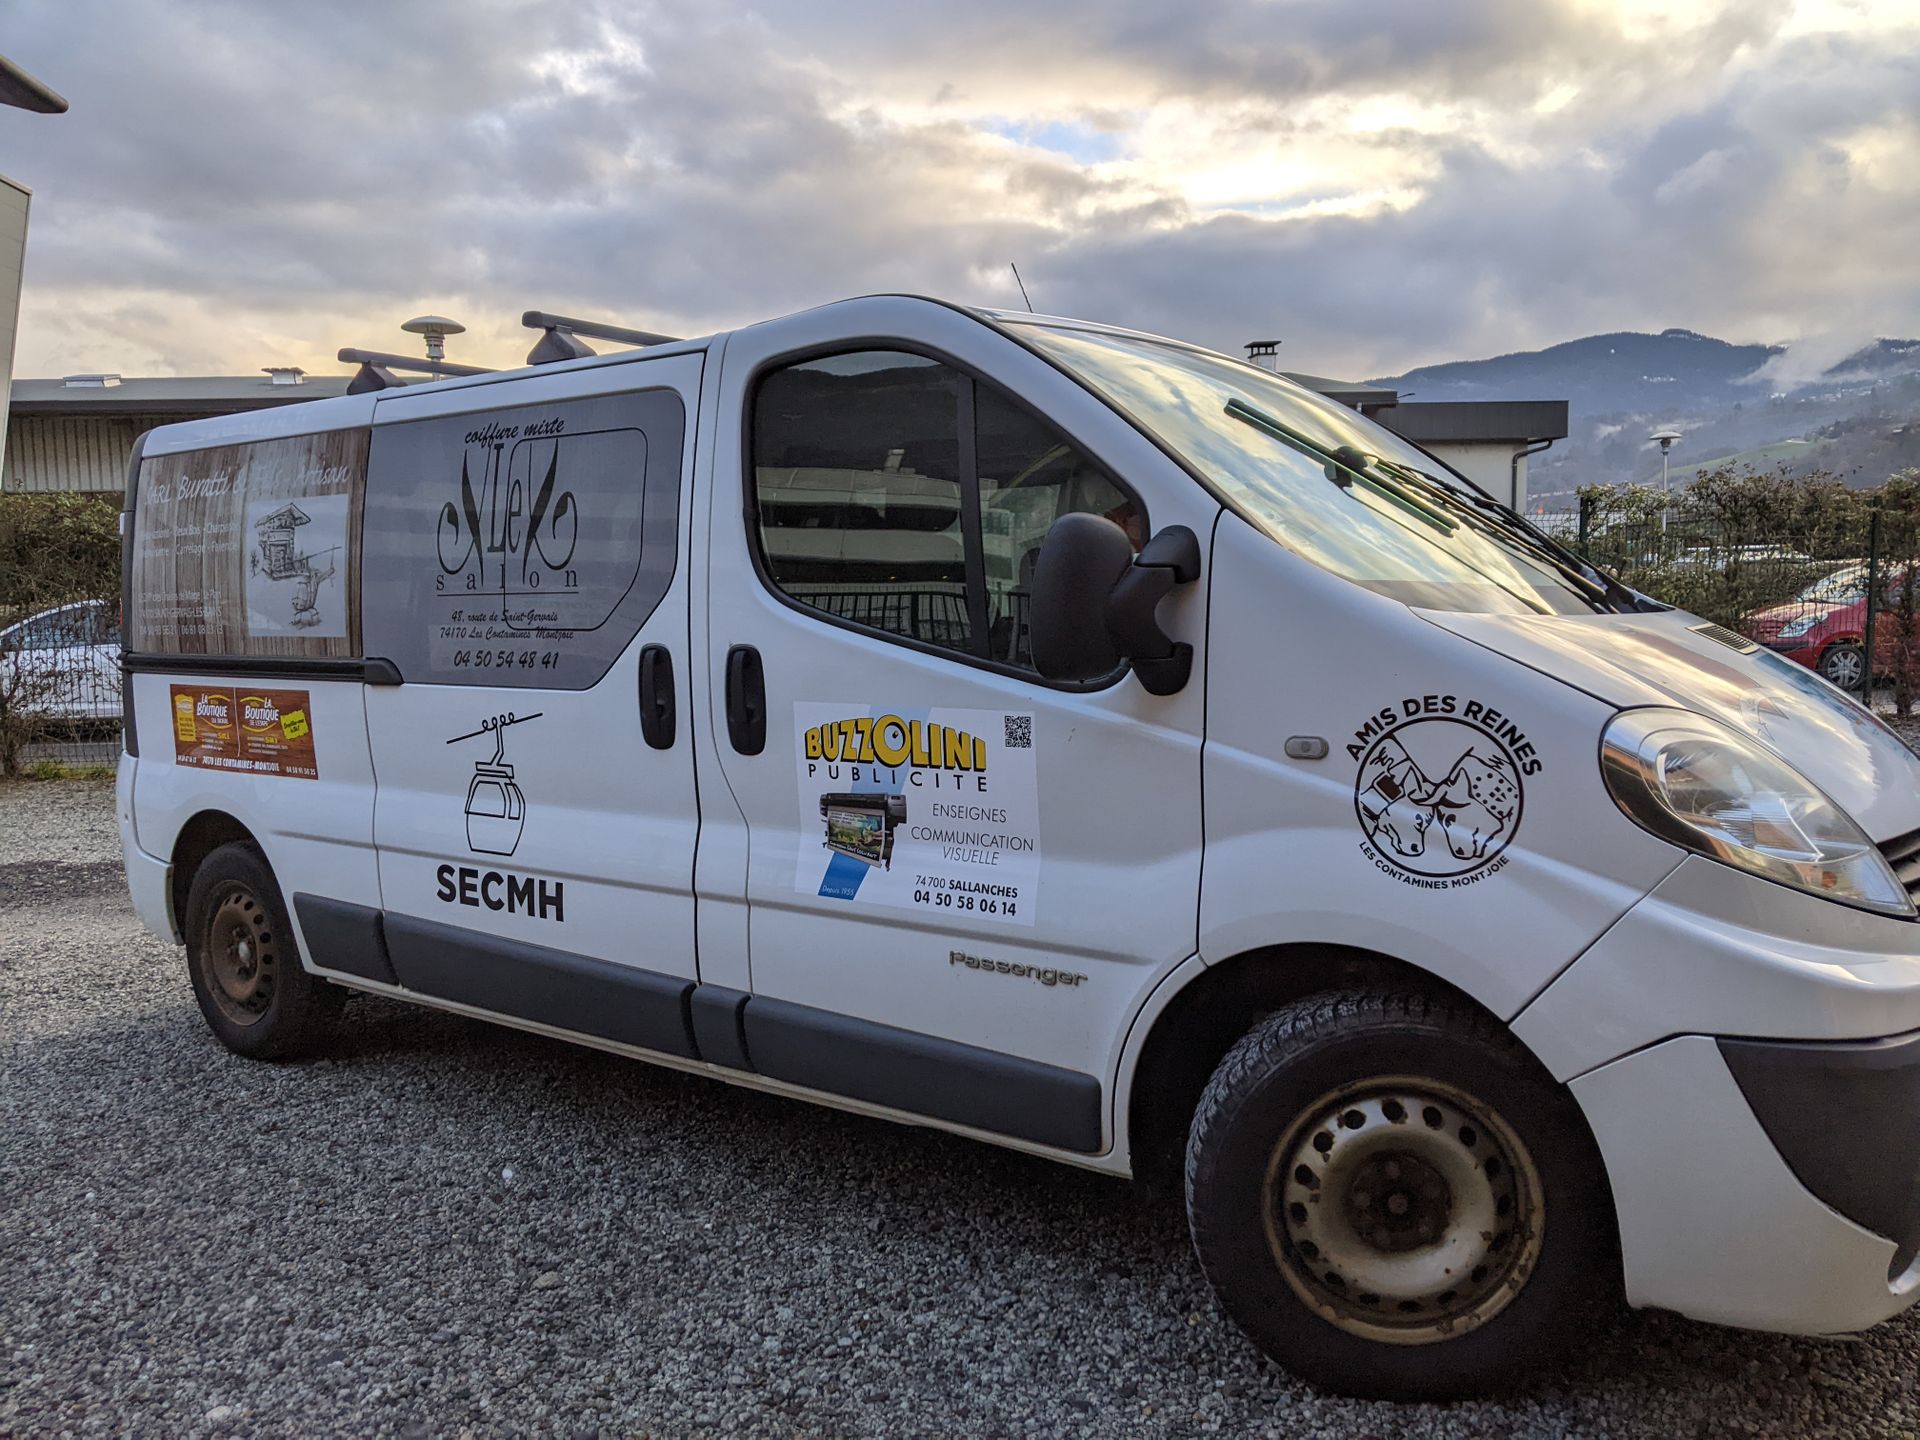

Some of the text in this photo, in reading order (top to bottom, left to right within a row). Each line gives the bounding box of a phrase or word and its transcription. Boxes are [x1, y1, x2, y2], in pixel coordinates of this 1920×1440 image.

[464, 417, 566, 448] coiffure mixte
[436, 563, 578, 590] salon
[467, 612, 487, 622] route
[489, 611, 499, 621] de
[501, 609, 559, 625] Saint-Gervais
[440, 625, 575, 642] 74170 Les Contamines Montjoie
[454, 650, 559, 669] 04 50 54 48 41
[197, 702, 228, 717] BOUTIQUE
[245, 705, 279, 721] BOUTIQUE
[264, 697, 272, 708] LA
[805, 714, 987, 772] BUZZOLINI
[1346, 695, 1543, 777] AMIS DES REINES
[808, 764, 988, 792] PUBLICITE
[932, 803, 1007, 823] ENSEIGNES
[911, 826, 1034, 852] COMMUNICATION
[943, 846, 1000, 866] VISUELLE
[1359, 841, 1511, 890] LES CONTAMINES MONTJOIE
[436, 864, 564, 922] SECMH
[949, 879, 1018, 898] SALLANCHES
[914, 890, 1017, 916] 04 50 58 06 14
[949, 950, 1089, 987] Passenger
